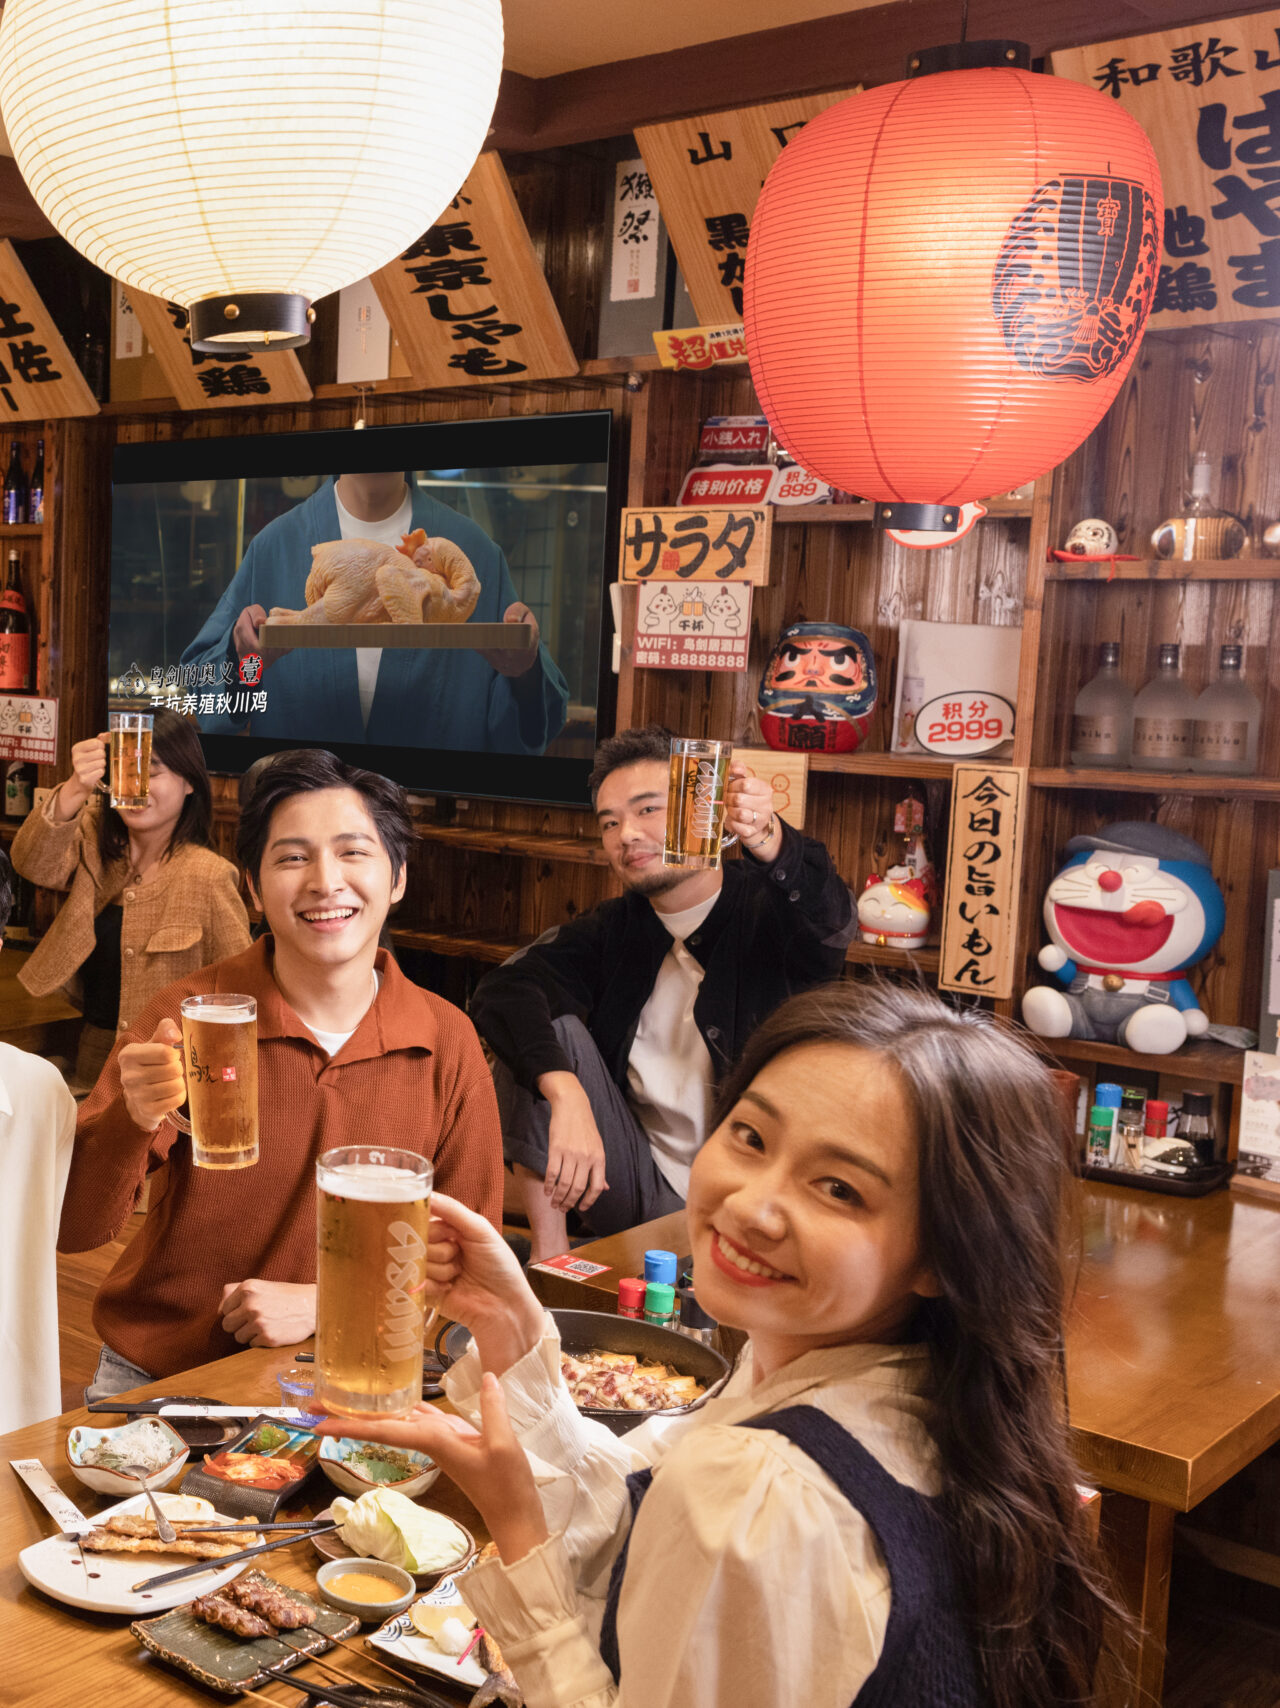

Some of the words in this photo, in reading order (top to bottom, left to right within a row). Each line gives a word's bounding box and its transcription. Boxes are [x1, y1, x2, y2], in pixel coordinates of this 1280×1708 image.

[401, 221, 528, 377] 東京しゃも
[690, 479, 765, 496] 特别价格
[778, 482, 818, 498] 899
[625, 511, 766, 578] サラダ
[678, 619, 704, 631] 干杯
[671, 653, 745, 668] 88888888
[149, 660, 234, 689] 鸟剑的奥义
[239, 655, 263, 686] 壹
[942, 700, 989, 720] 积分
[927, 718, 1003, 743] 2999
[954, 776, 1012, 986] 今日の旨いもん
